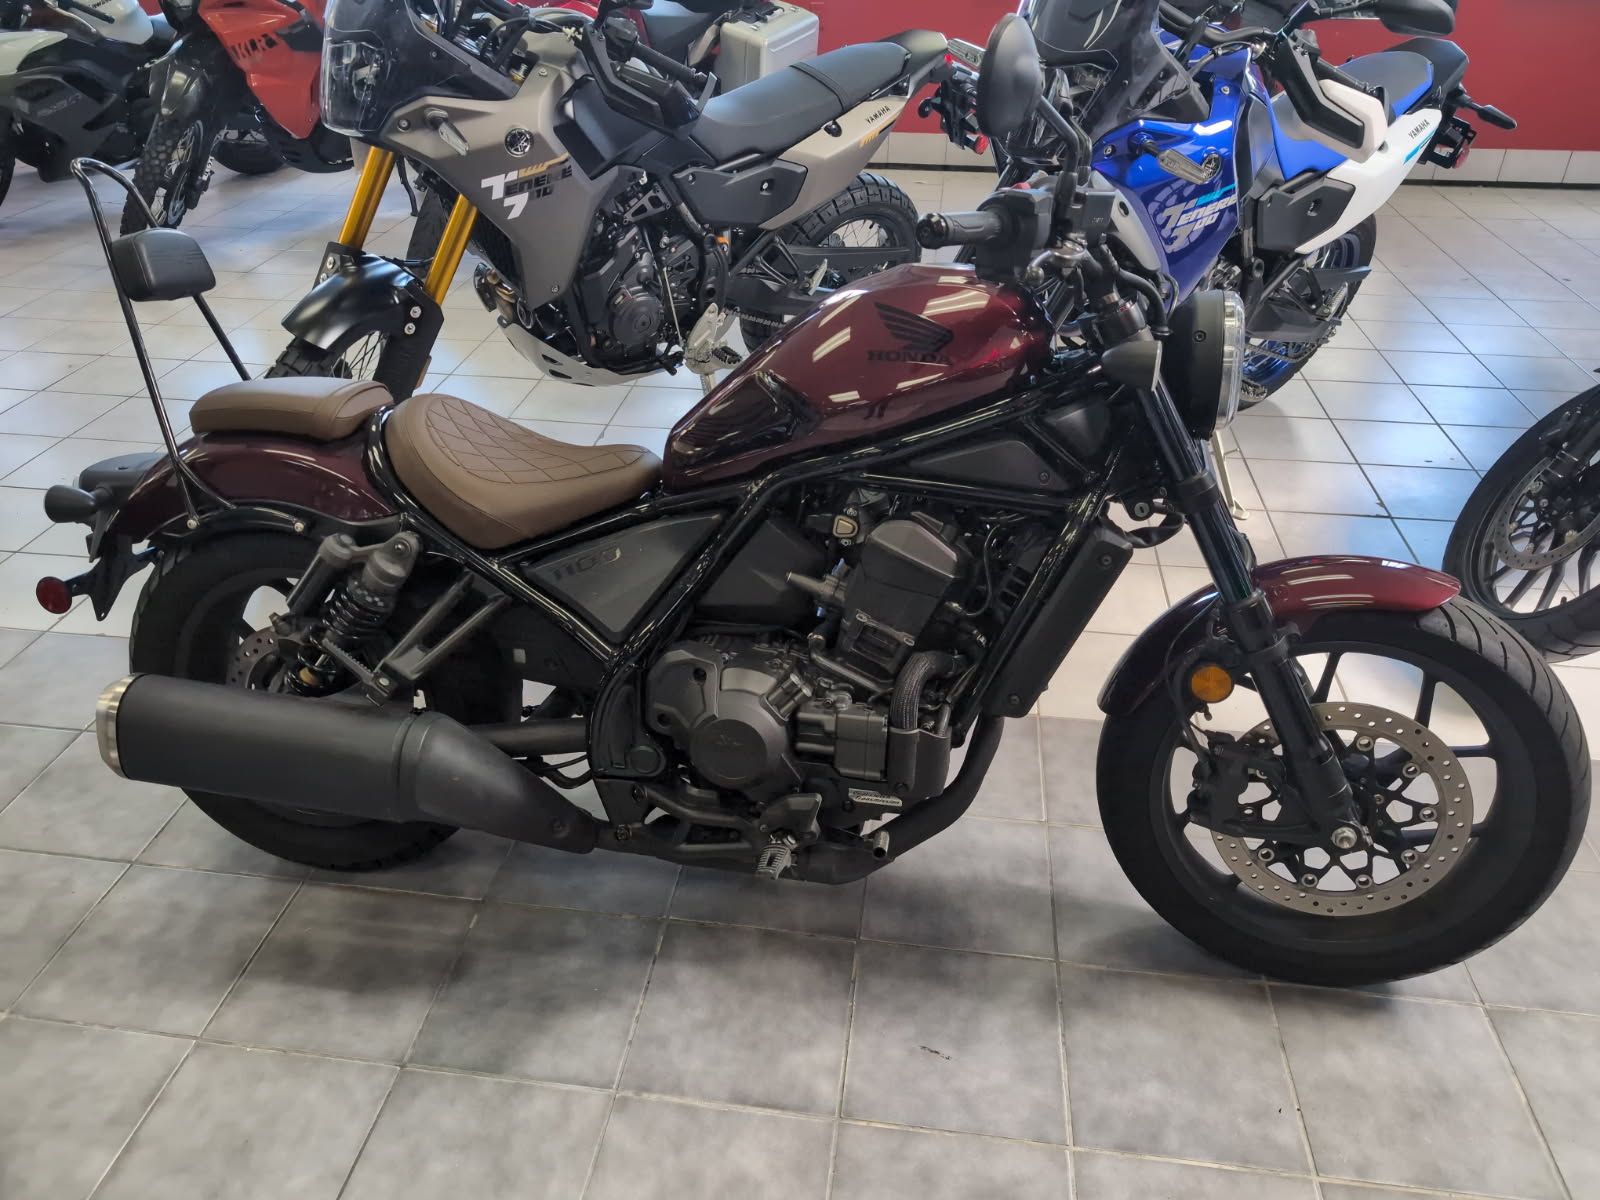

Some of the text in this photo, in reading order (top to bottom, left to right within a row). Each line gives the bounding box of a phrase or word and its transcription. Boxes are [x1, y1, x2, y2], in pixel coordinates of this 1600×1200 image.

[865, 105, 891, 124] YAMAHA
[1408, 119, 1431, 139] YAMAHA
[866, 350, 954, 365] HONDA
